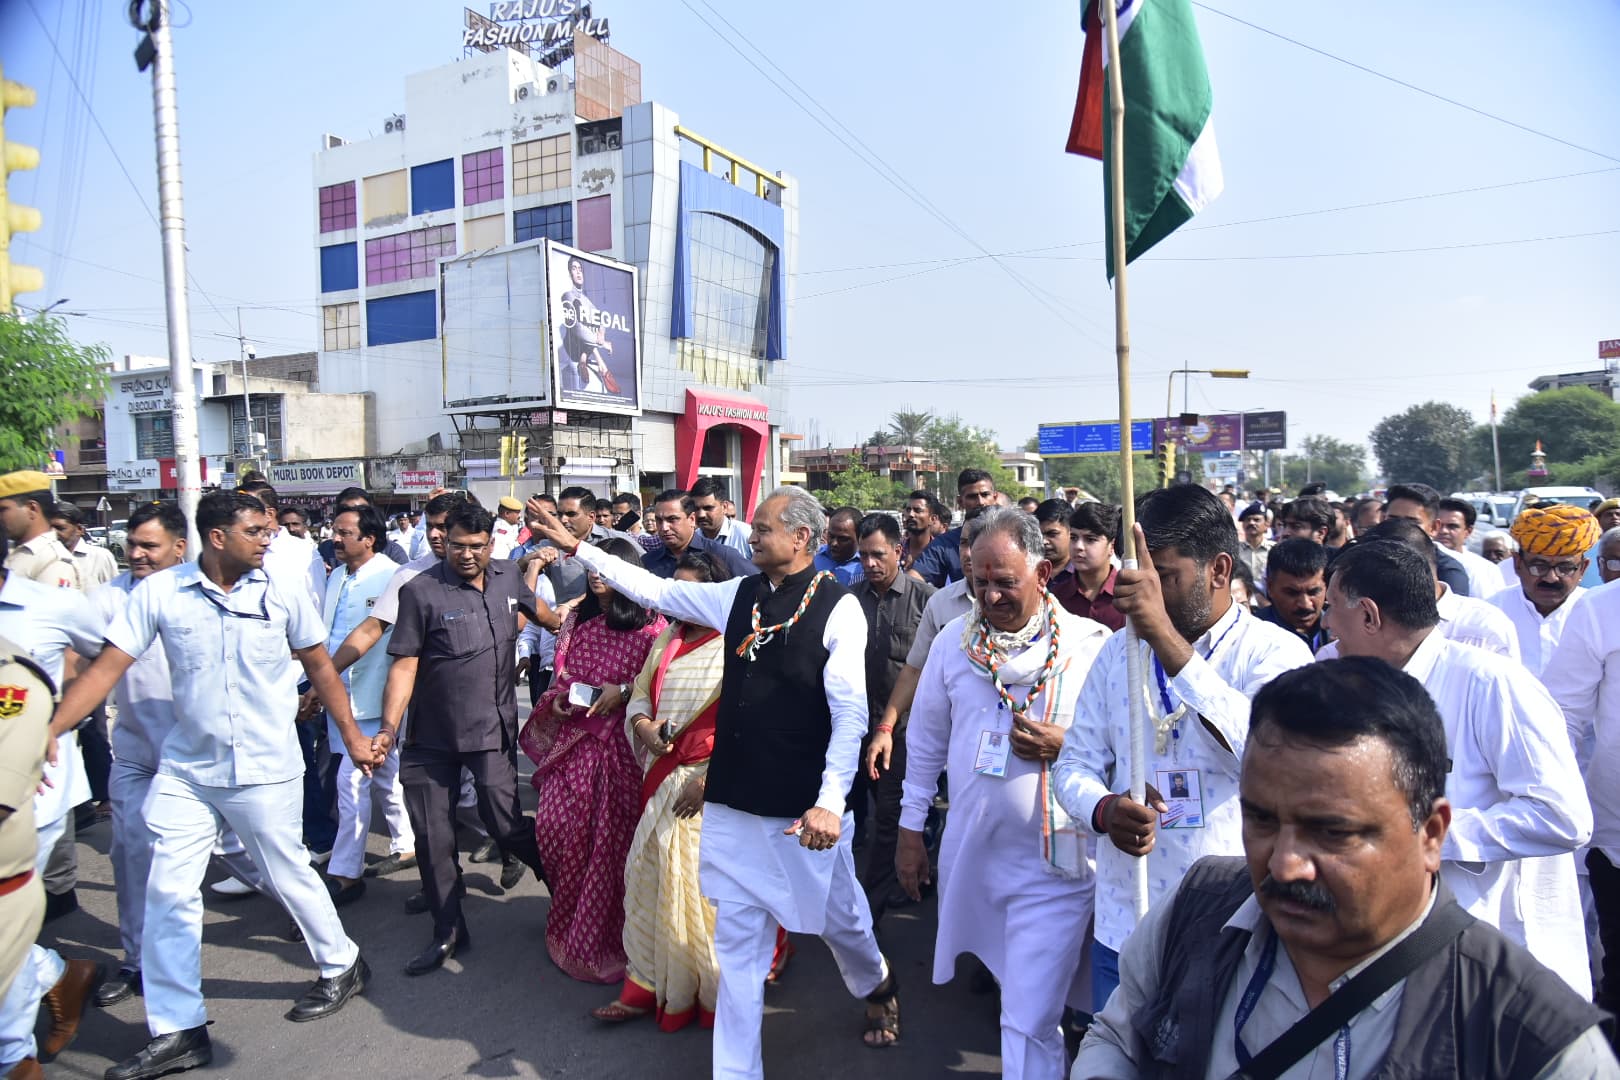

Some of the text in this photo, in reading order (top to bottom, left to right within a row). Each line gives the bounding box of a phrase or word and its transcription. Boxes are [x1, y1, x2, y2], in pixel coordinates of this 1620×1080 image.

[492, 0, 577, 21] RAJU'S
[464, 18, 608, 46] FASHION MALL
[579, 305, 631, 333] REGAL
[128, 399, 161, 413] DISCOUNT
[698, 404, 723, 417] RAJU'S
[724, 407, 753, 419] FASHION
[135, 466, 157, 479] KART
[273, 465, 355, 482] MURLI BOOK DEPOT
